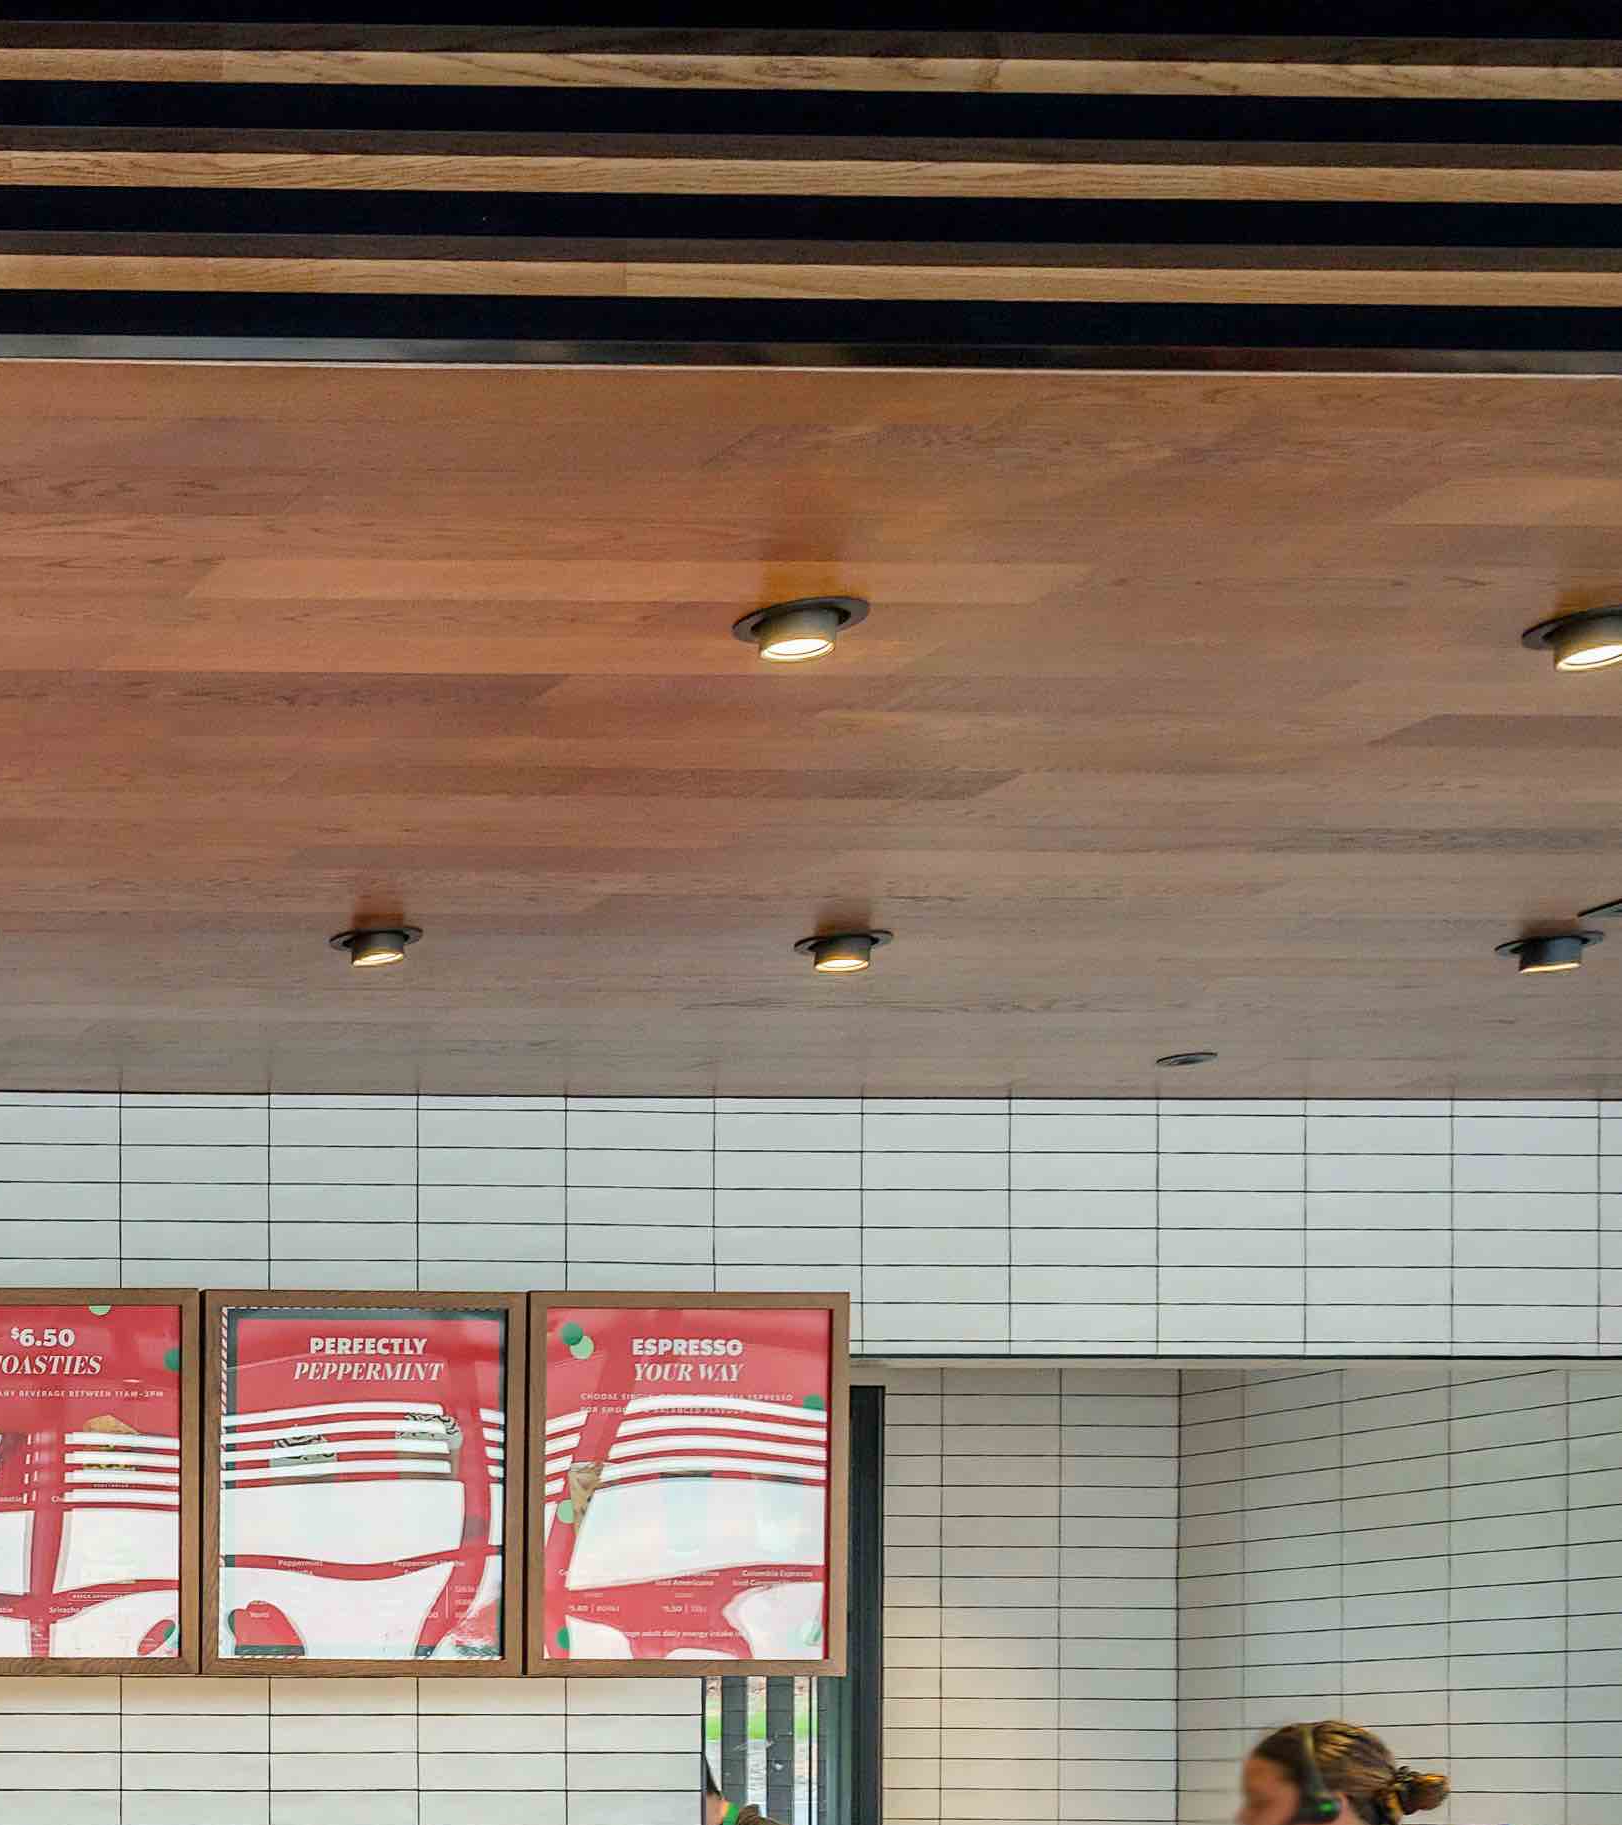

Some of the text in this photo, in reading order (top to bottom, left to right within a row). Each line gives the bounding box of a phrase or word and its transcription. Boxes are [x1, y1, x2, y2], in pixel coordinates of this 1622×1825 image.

[10, 1327, 75, 1347] $6.50
[310, 1337, 428, 1355] PERFECTLY
[632, 1338, 744, 1356] ESPRESSO
[294, 1362, 444, 1381] PEPPERMINT
[634, 1363, 744, 1382] YOUR WAY
